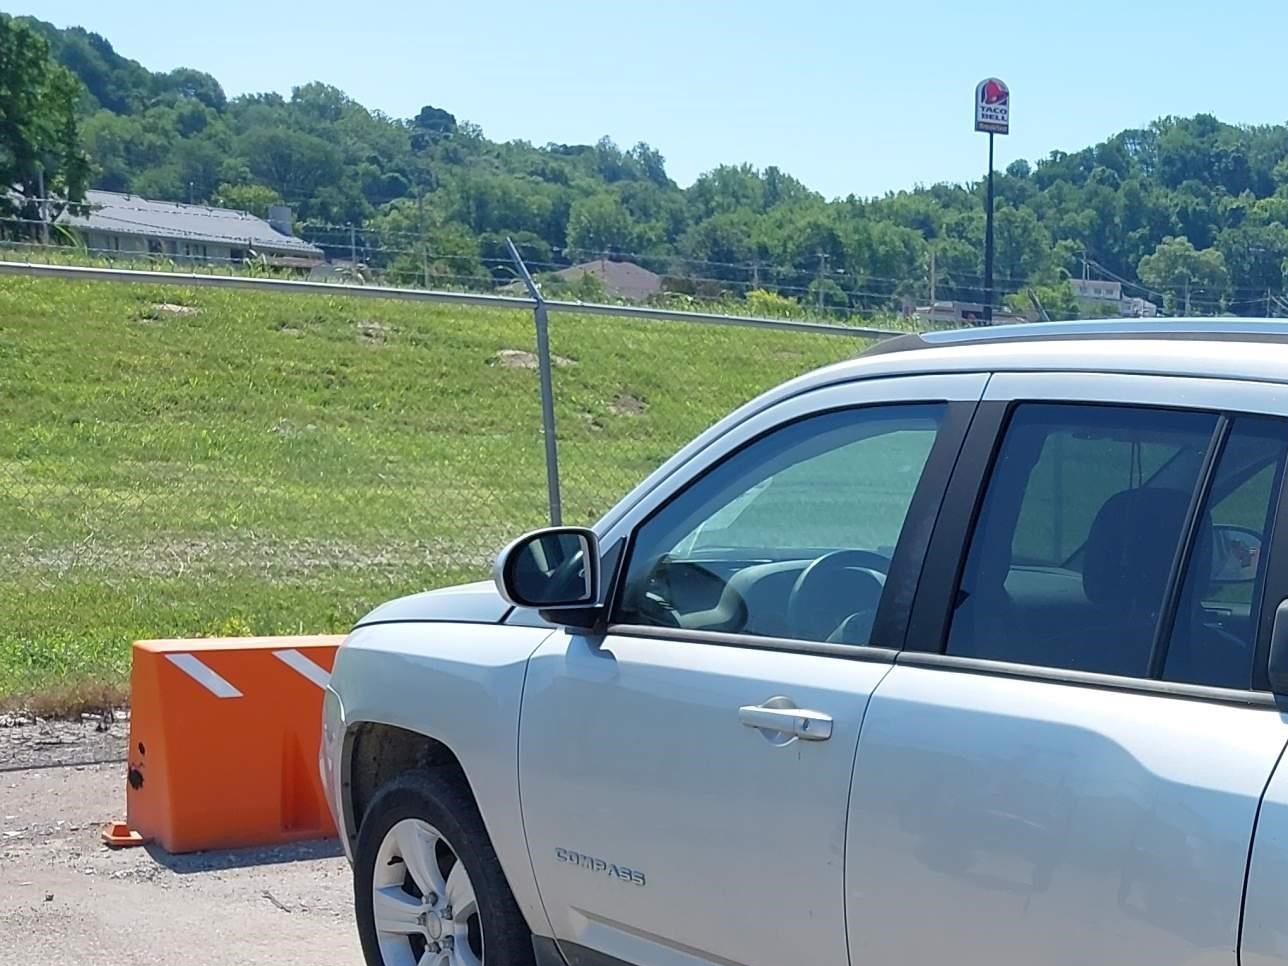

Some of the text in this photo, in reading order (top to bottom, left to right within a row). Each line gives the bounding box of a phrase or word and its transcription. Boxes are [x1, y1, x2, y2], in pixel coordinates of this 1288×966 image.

[980, 105, 1007, 115] TACO
[981, 113, 1008, 121] BELL
[554, 846, 647, 887] COMPASS
